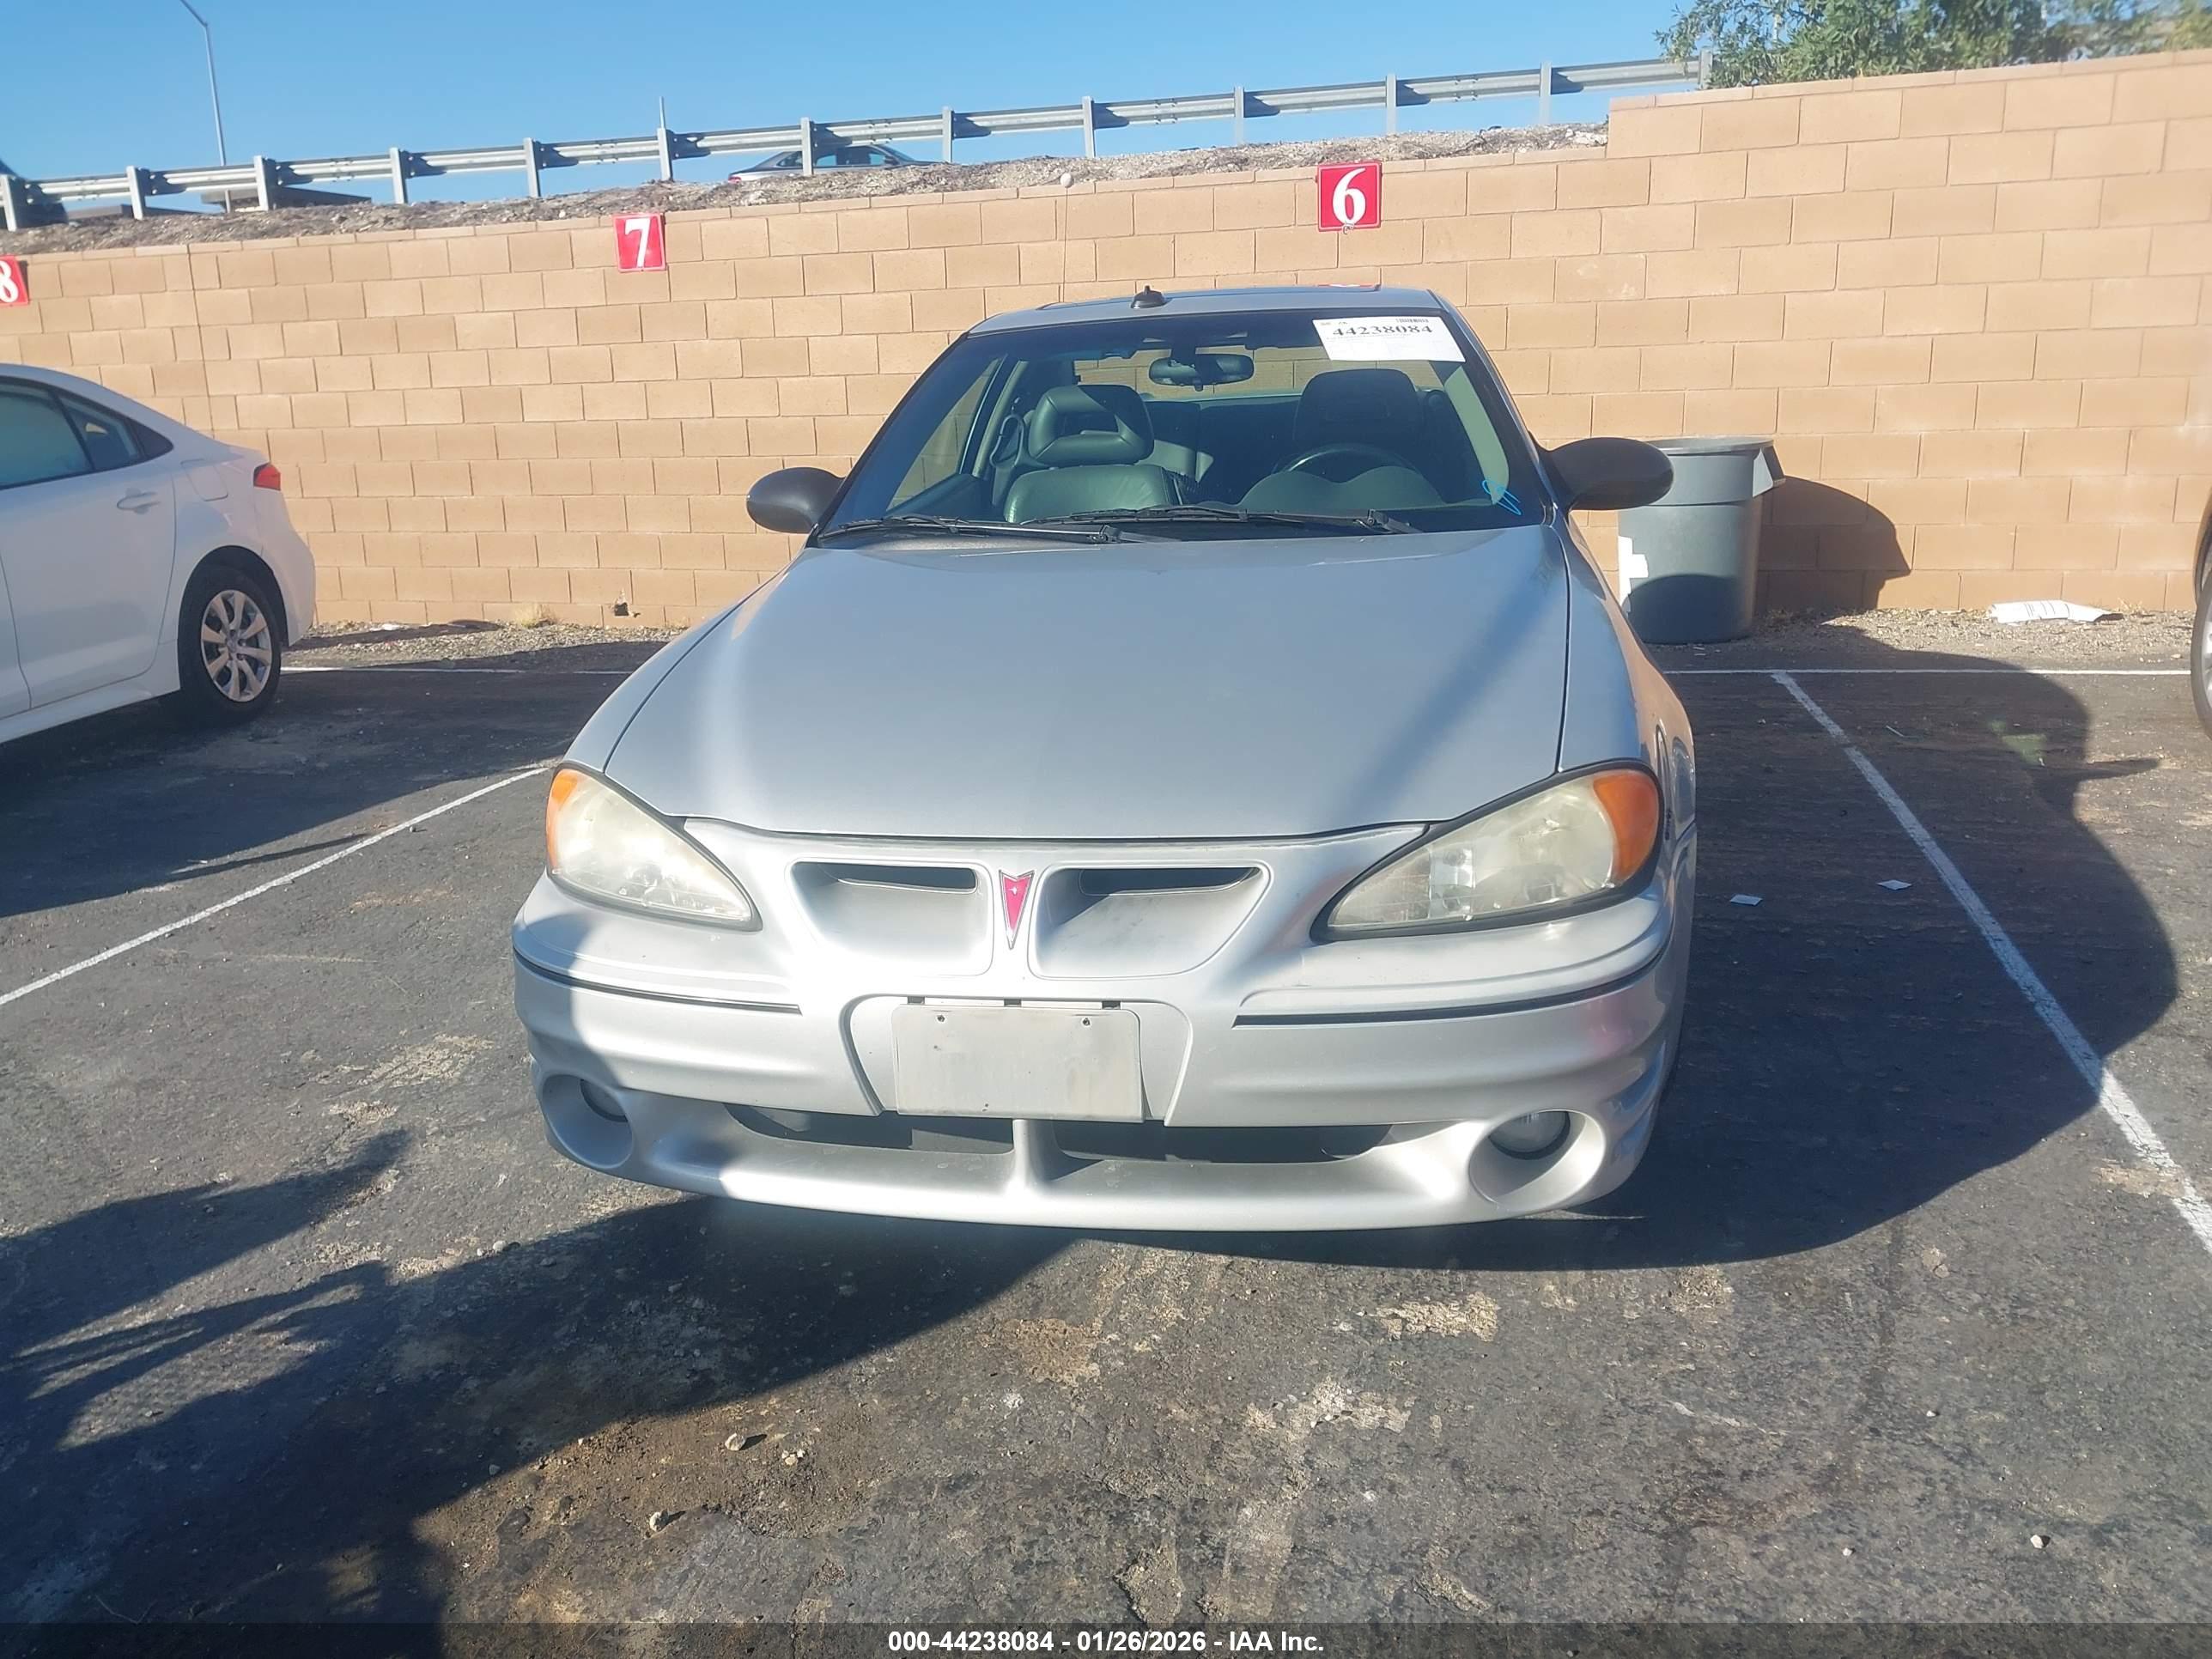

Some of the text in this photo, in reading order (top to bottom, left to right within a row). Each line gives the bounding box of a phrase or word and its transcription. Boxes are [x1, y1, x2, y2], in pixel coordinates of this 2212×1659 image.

[1333, 167, 1366, 226] 6
[624, 217, 651, 268] 7
[0, 260, 19, 303] 8
[1332, 325, 1433, 337] 44238084
